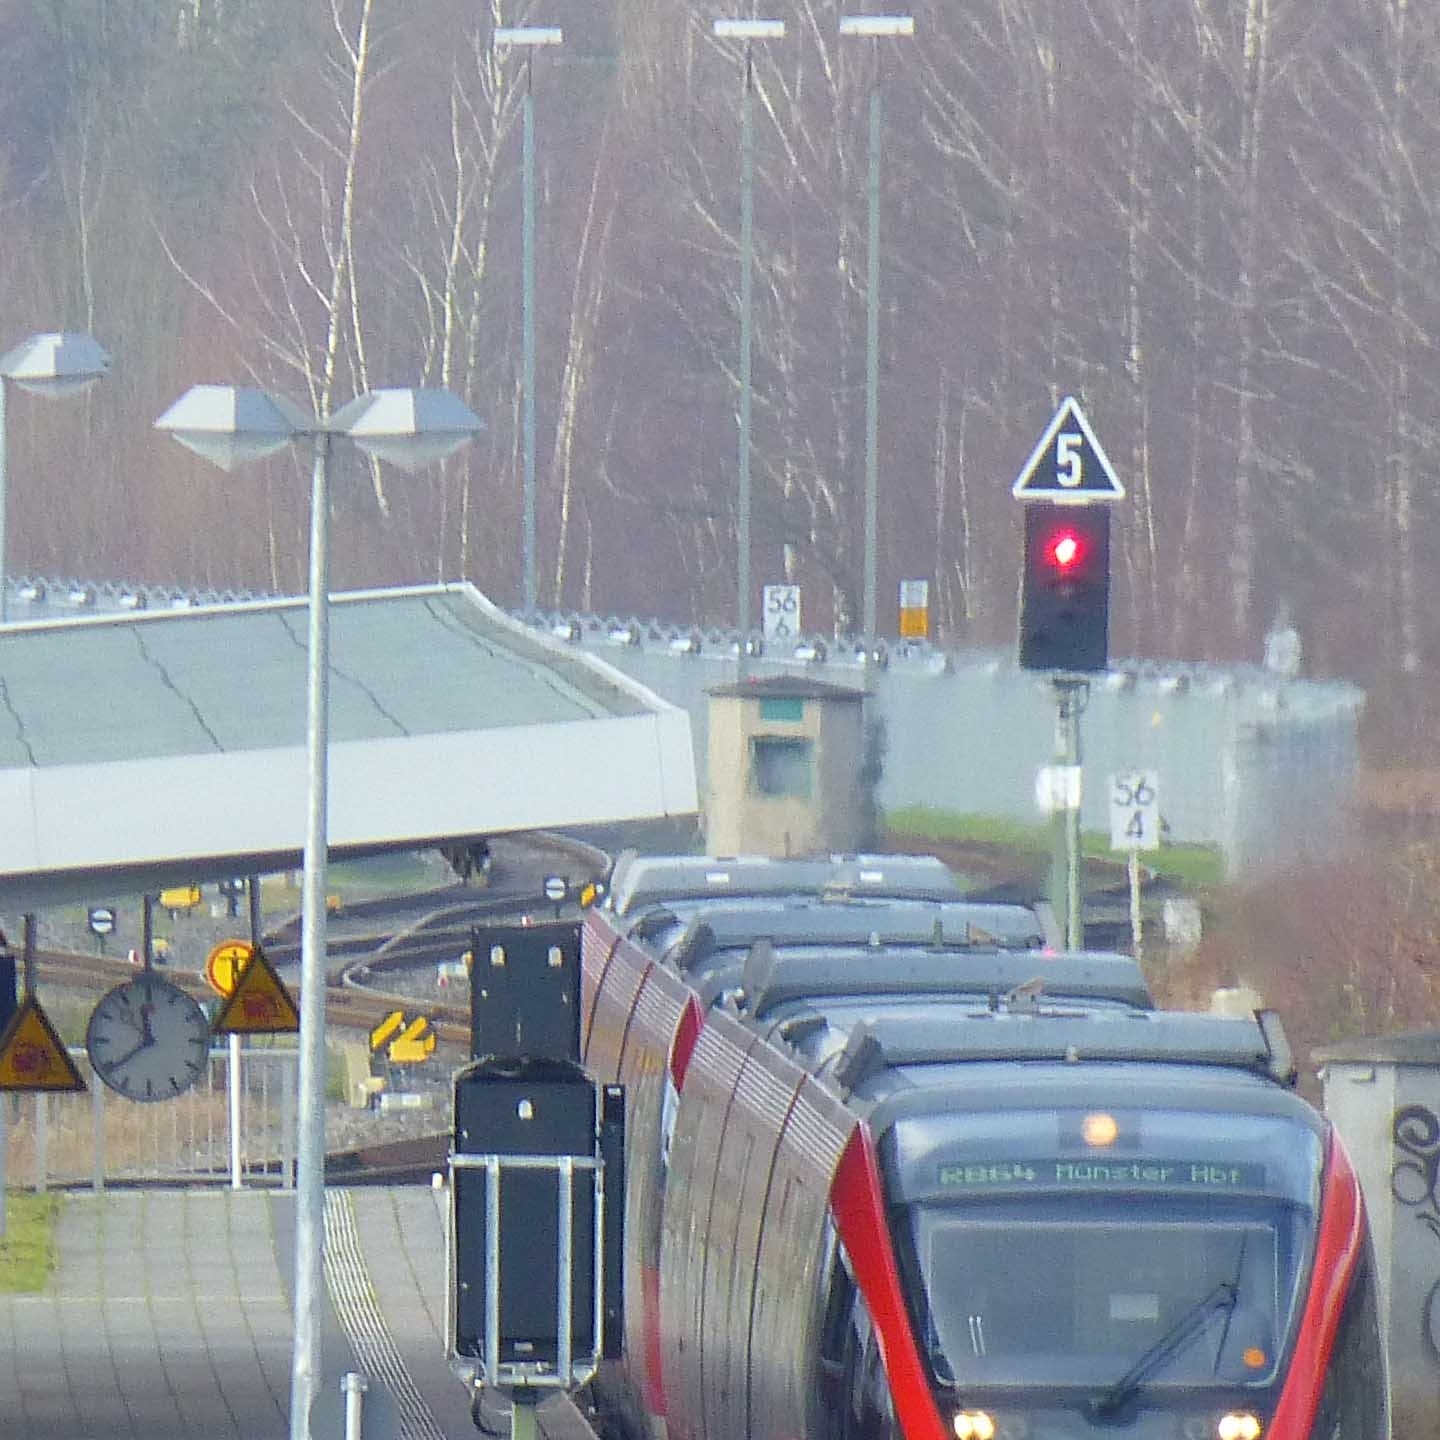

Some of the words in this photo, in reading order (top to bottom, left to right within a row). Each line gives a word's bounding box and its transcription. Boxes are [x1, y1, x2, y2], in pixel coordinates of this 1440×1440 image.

[1056, 432, 1083, 488] 5
[767, 588, 797, 614] 56
[1114, 773, 1157, 807] 56
[1125, 809, 1144, 839] 4
